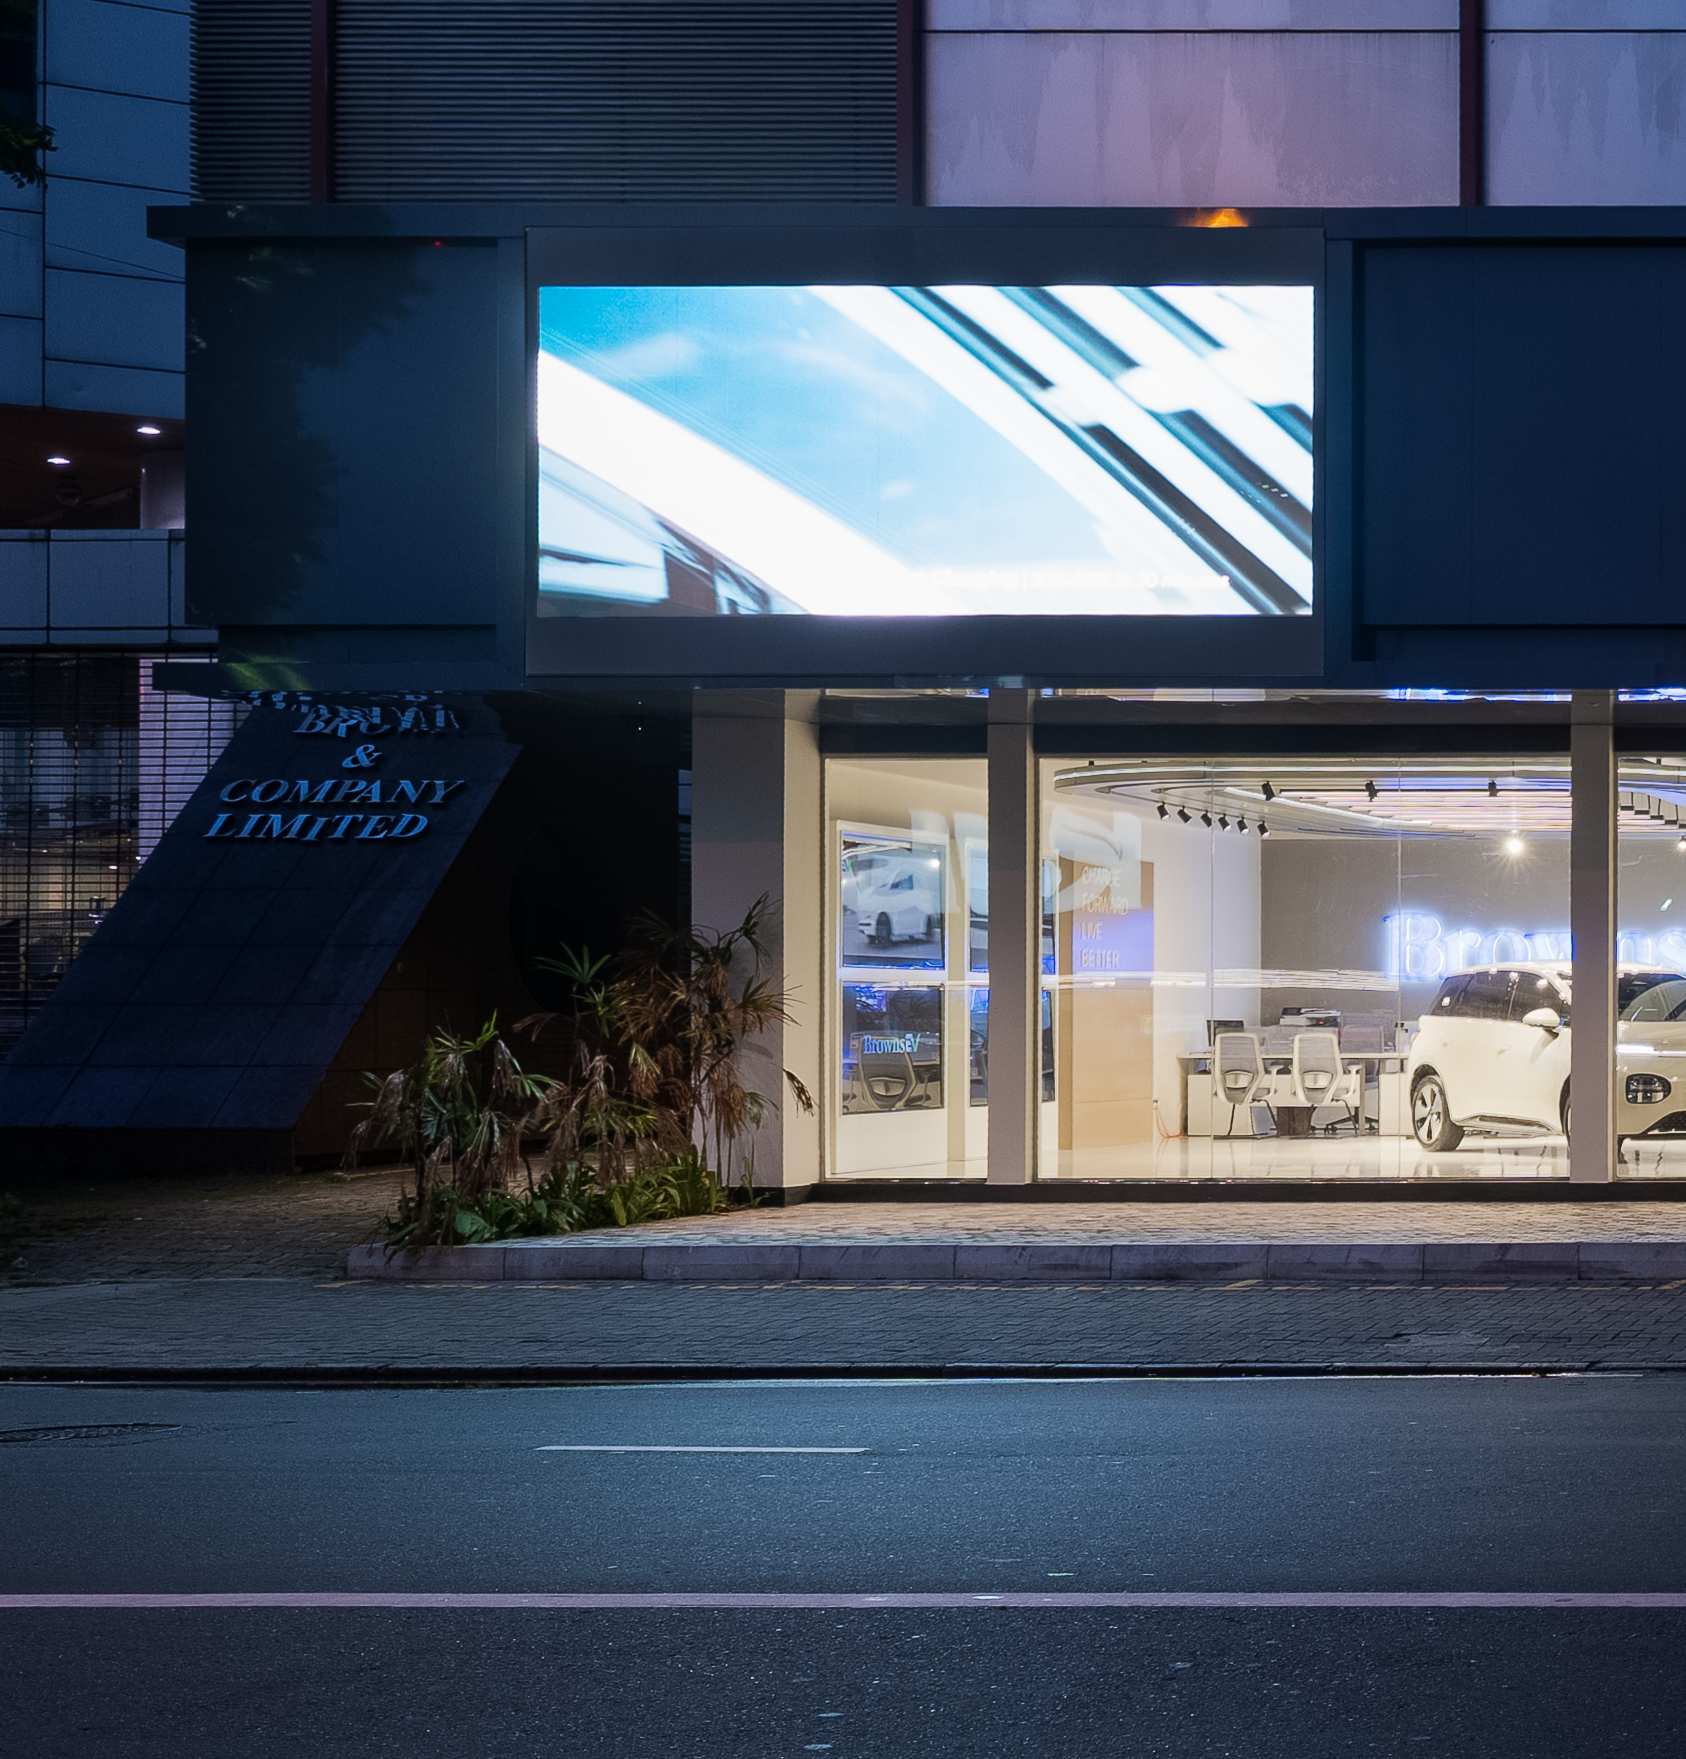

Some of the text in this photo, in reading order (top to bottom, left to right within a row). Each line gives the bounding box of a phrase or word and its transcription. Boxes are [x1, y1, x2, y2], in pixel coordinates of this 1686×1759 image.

[341, 743, 383, 769] &
[219, 778, 466, 805] COMPANY
[202, 812, 430, 842] LIMITED
[1080, 948, 1120, 969] BETTER
